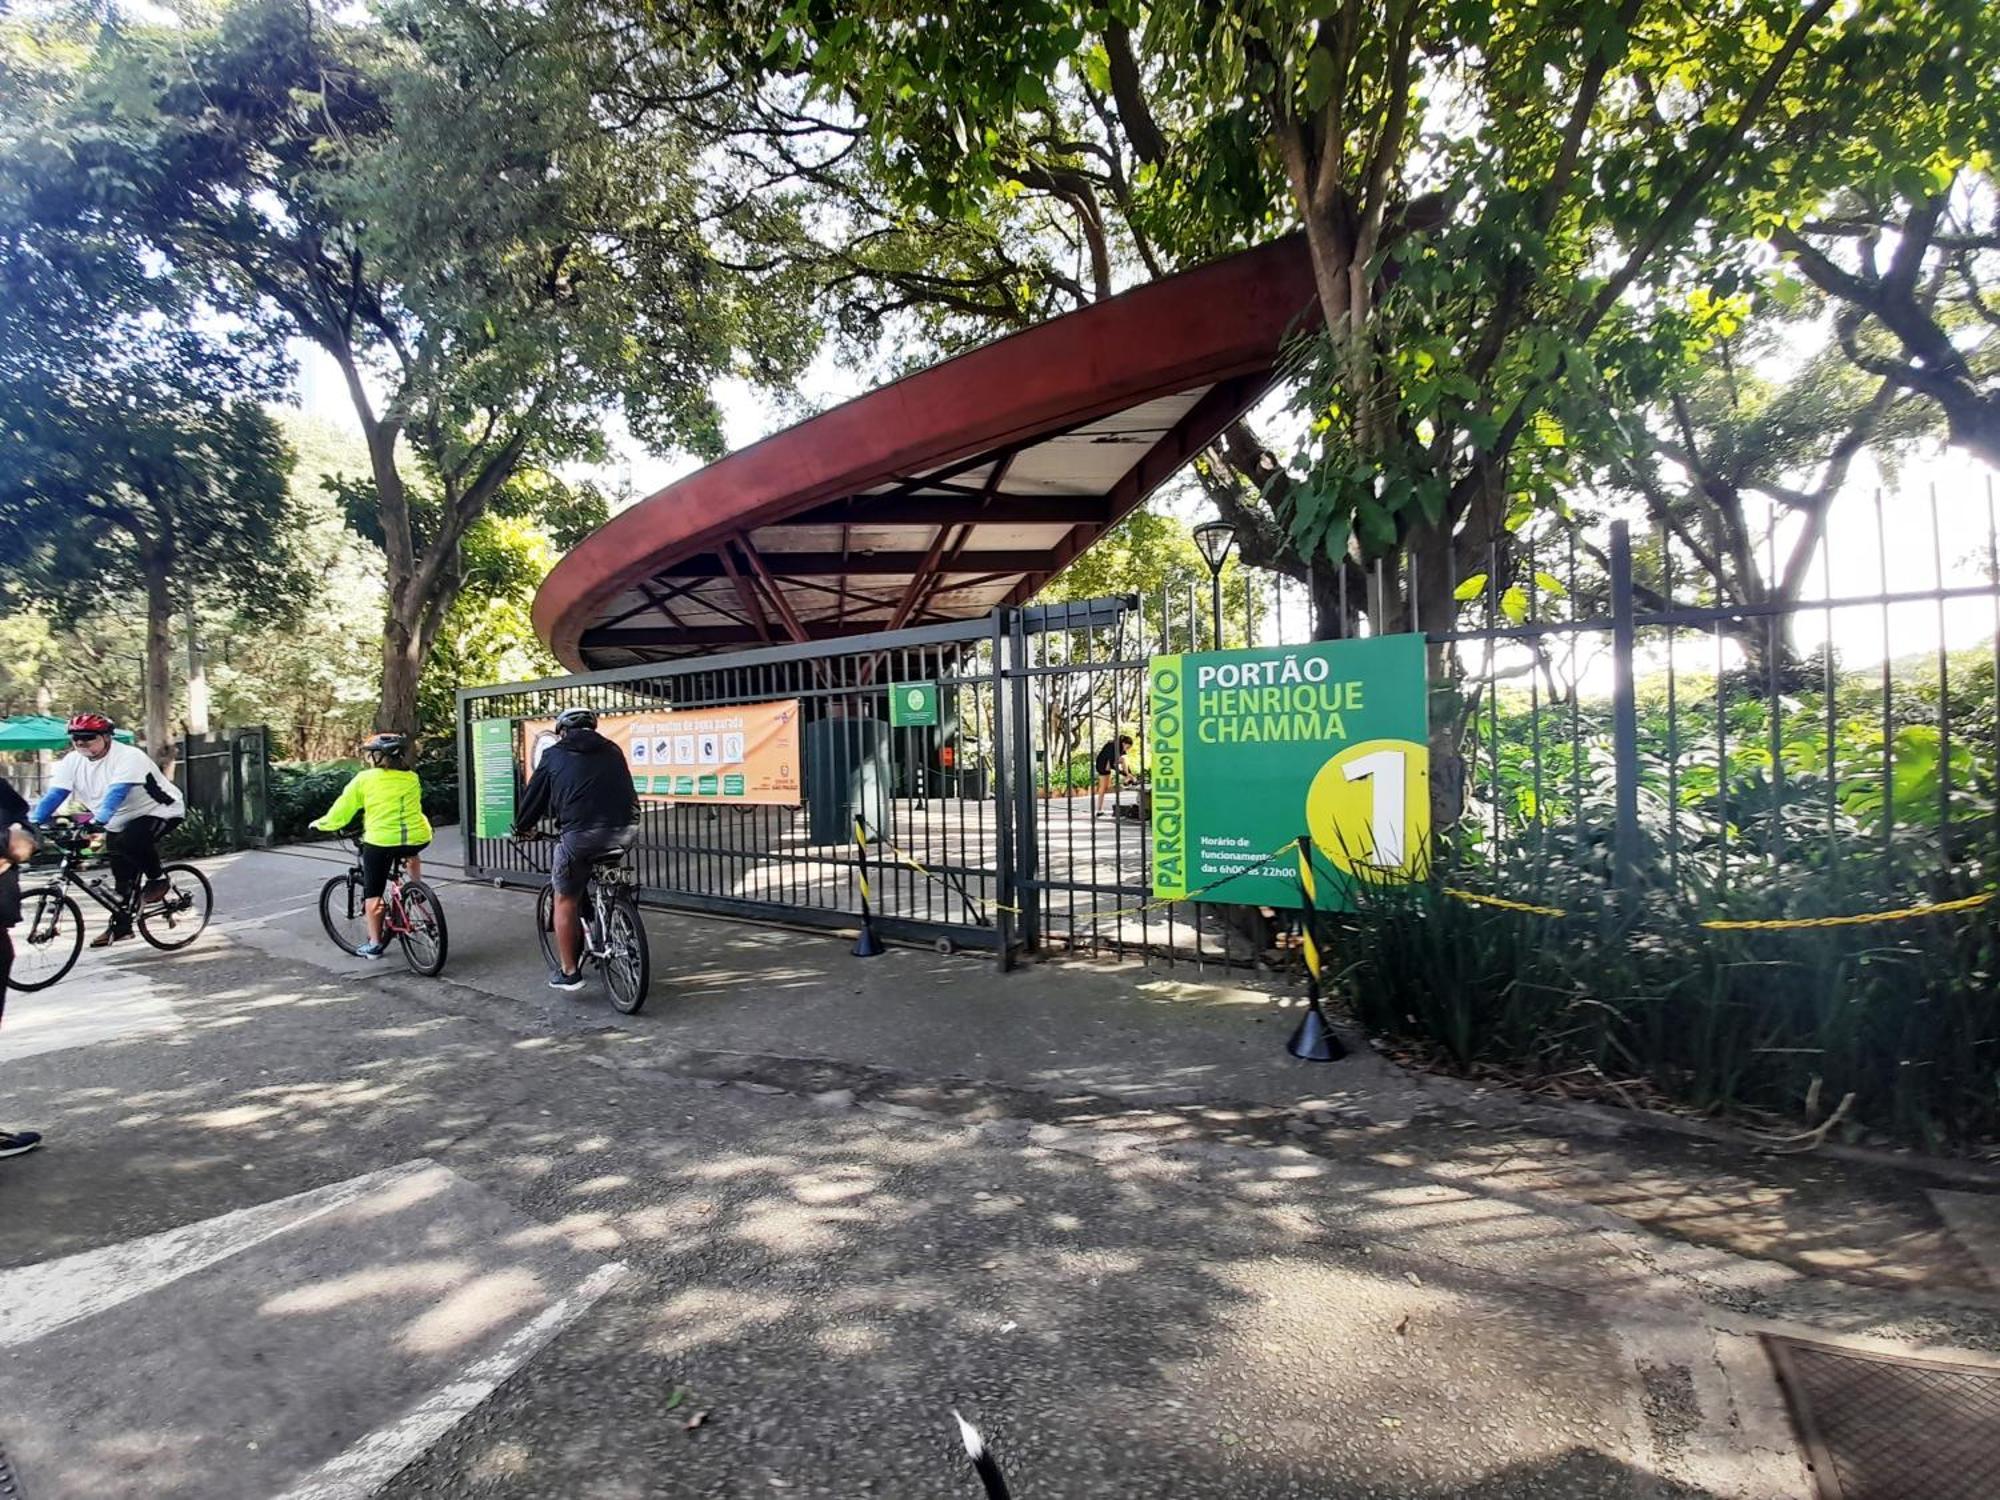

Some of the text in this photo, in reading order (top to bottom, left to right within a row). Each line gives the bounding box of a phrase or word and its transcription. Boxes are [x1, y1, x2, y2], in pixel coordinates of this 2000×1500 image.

[1197, 654, 1329, 688] PORTÃO
[1198, 681, 1364, 717] HENRIQUE
[1197, 712, 1347, 743] CHAMMA
[1154, 668, 1182, 888] PARQUE DO POVO
[1341, 750, 1405, 867] 1
[1200, 836, 1249, 847] Horário de
[1200, 863, 1218, 873] das
[1262, 866, 1296, 877] 22h00
